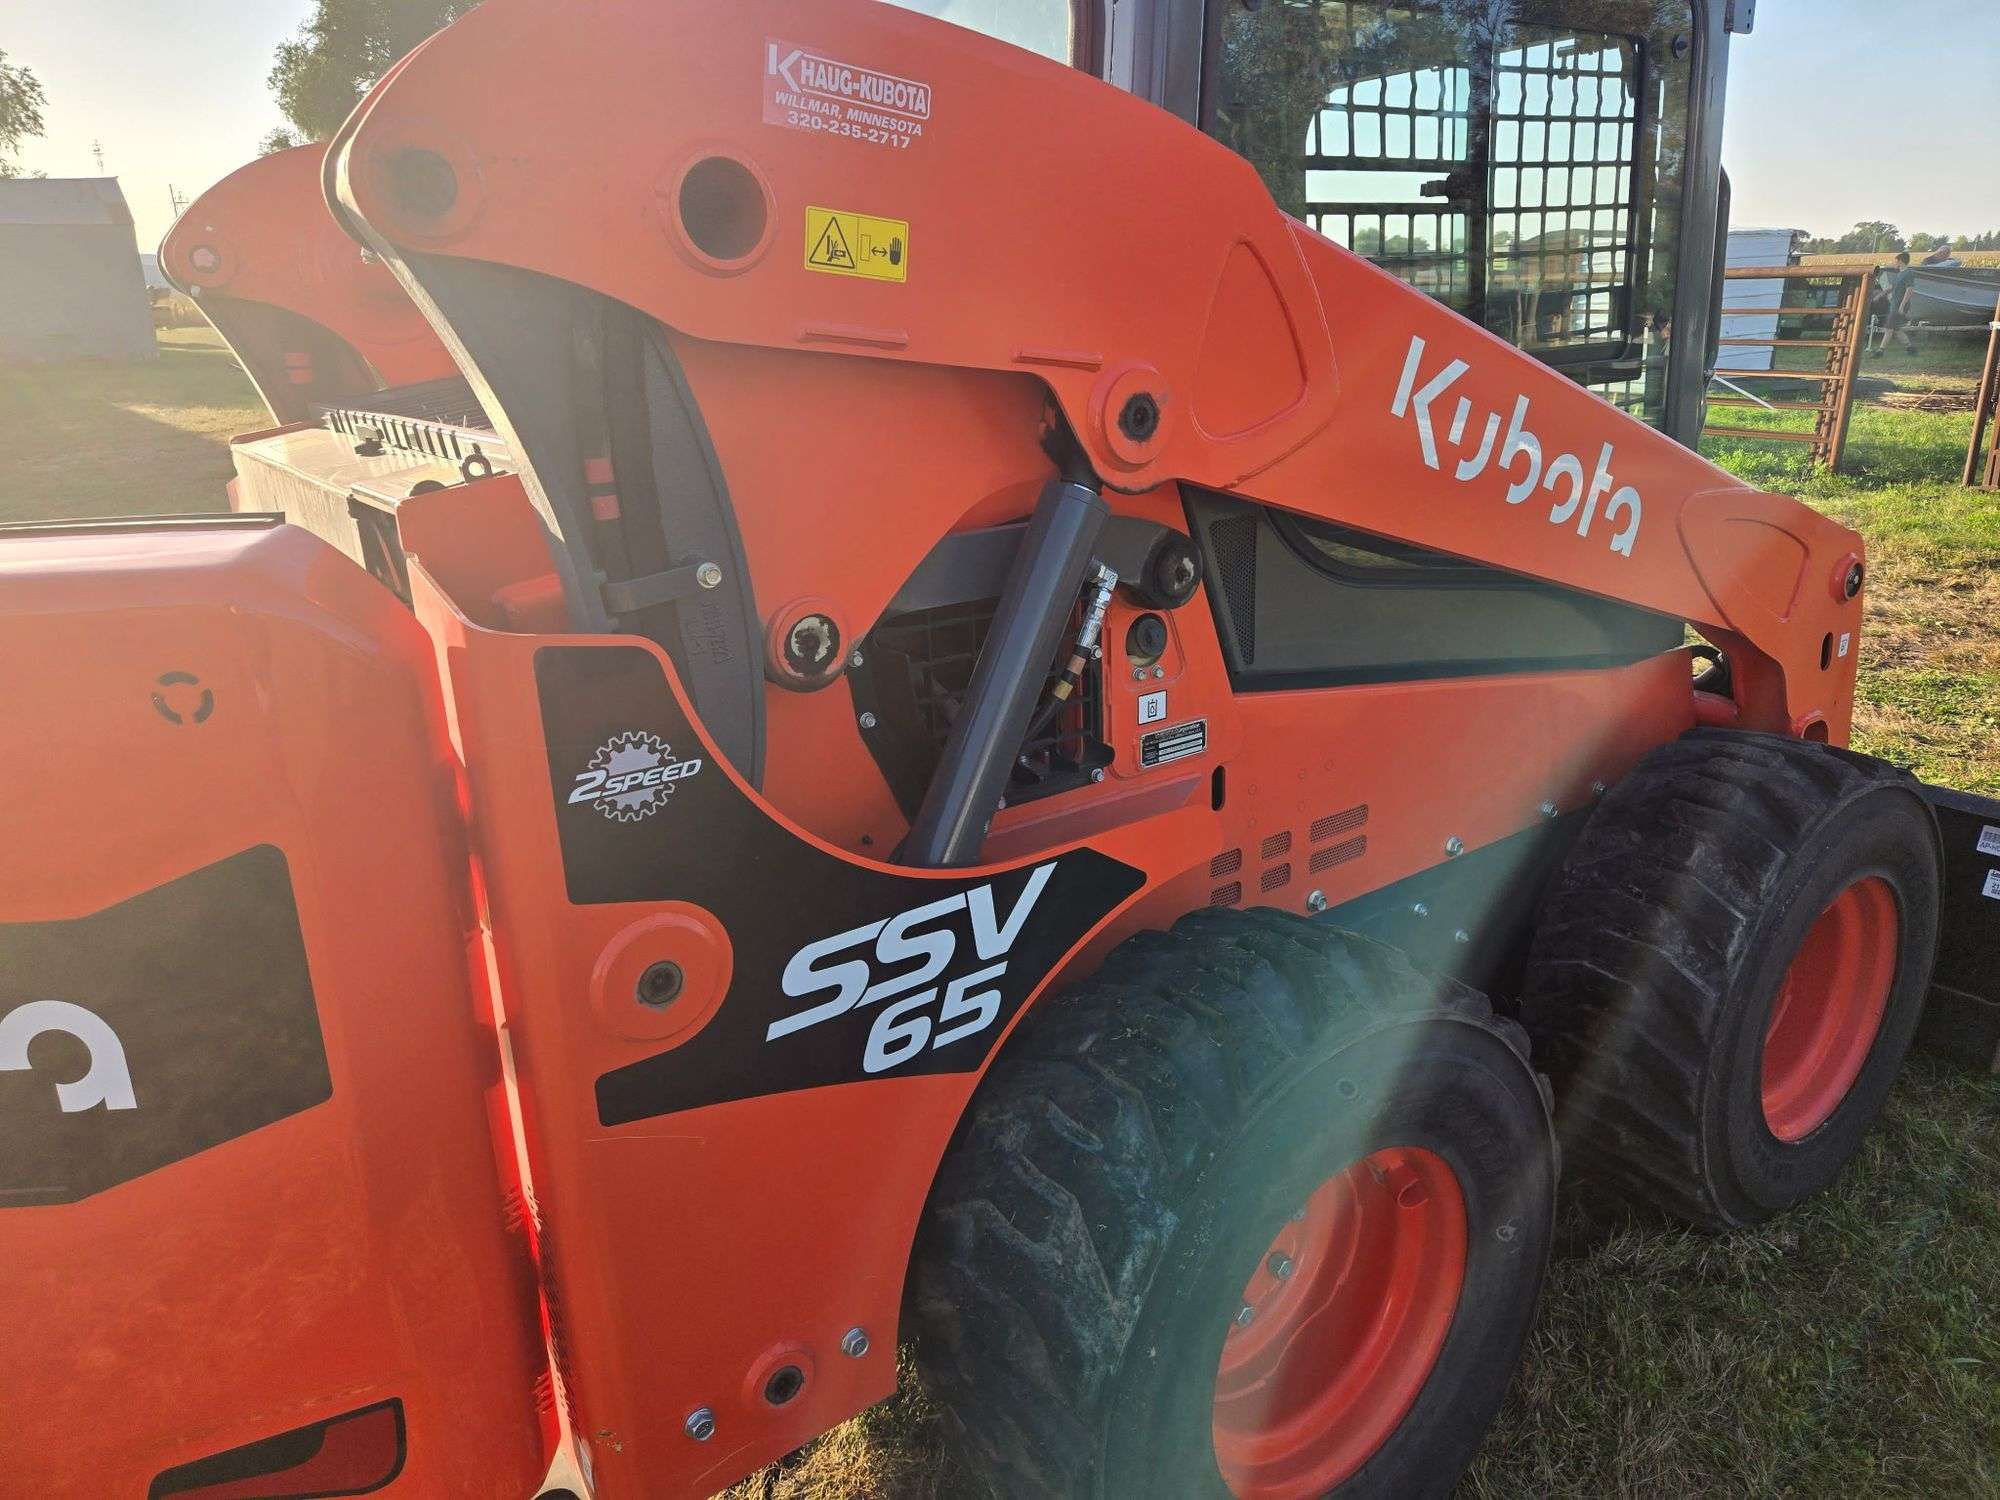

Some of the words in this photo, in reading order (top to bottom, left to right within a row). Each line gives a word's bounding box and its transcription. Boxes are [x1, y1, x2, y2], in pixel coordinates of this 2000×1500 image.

[775, 91, 843, 120] WILLMAR,
[846, 108, 922, 136] MINNESOTA
[800, 59, 927, 114] HAUG-KUBOTA
[787, 111, 911, 149] 320-235-2717
[1391, 335, 1642, 558] Kubota
[765, 862, 1058, 1042] SSV
[862, 960, 1008, 1074] 65
